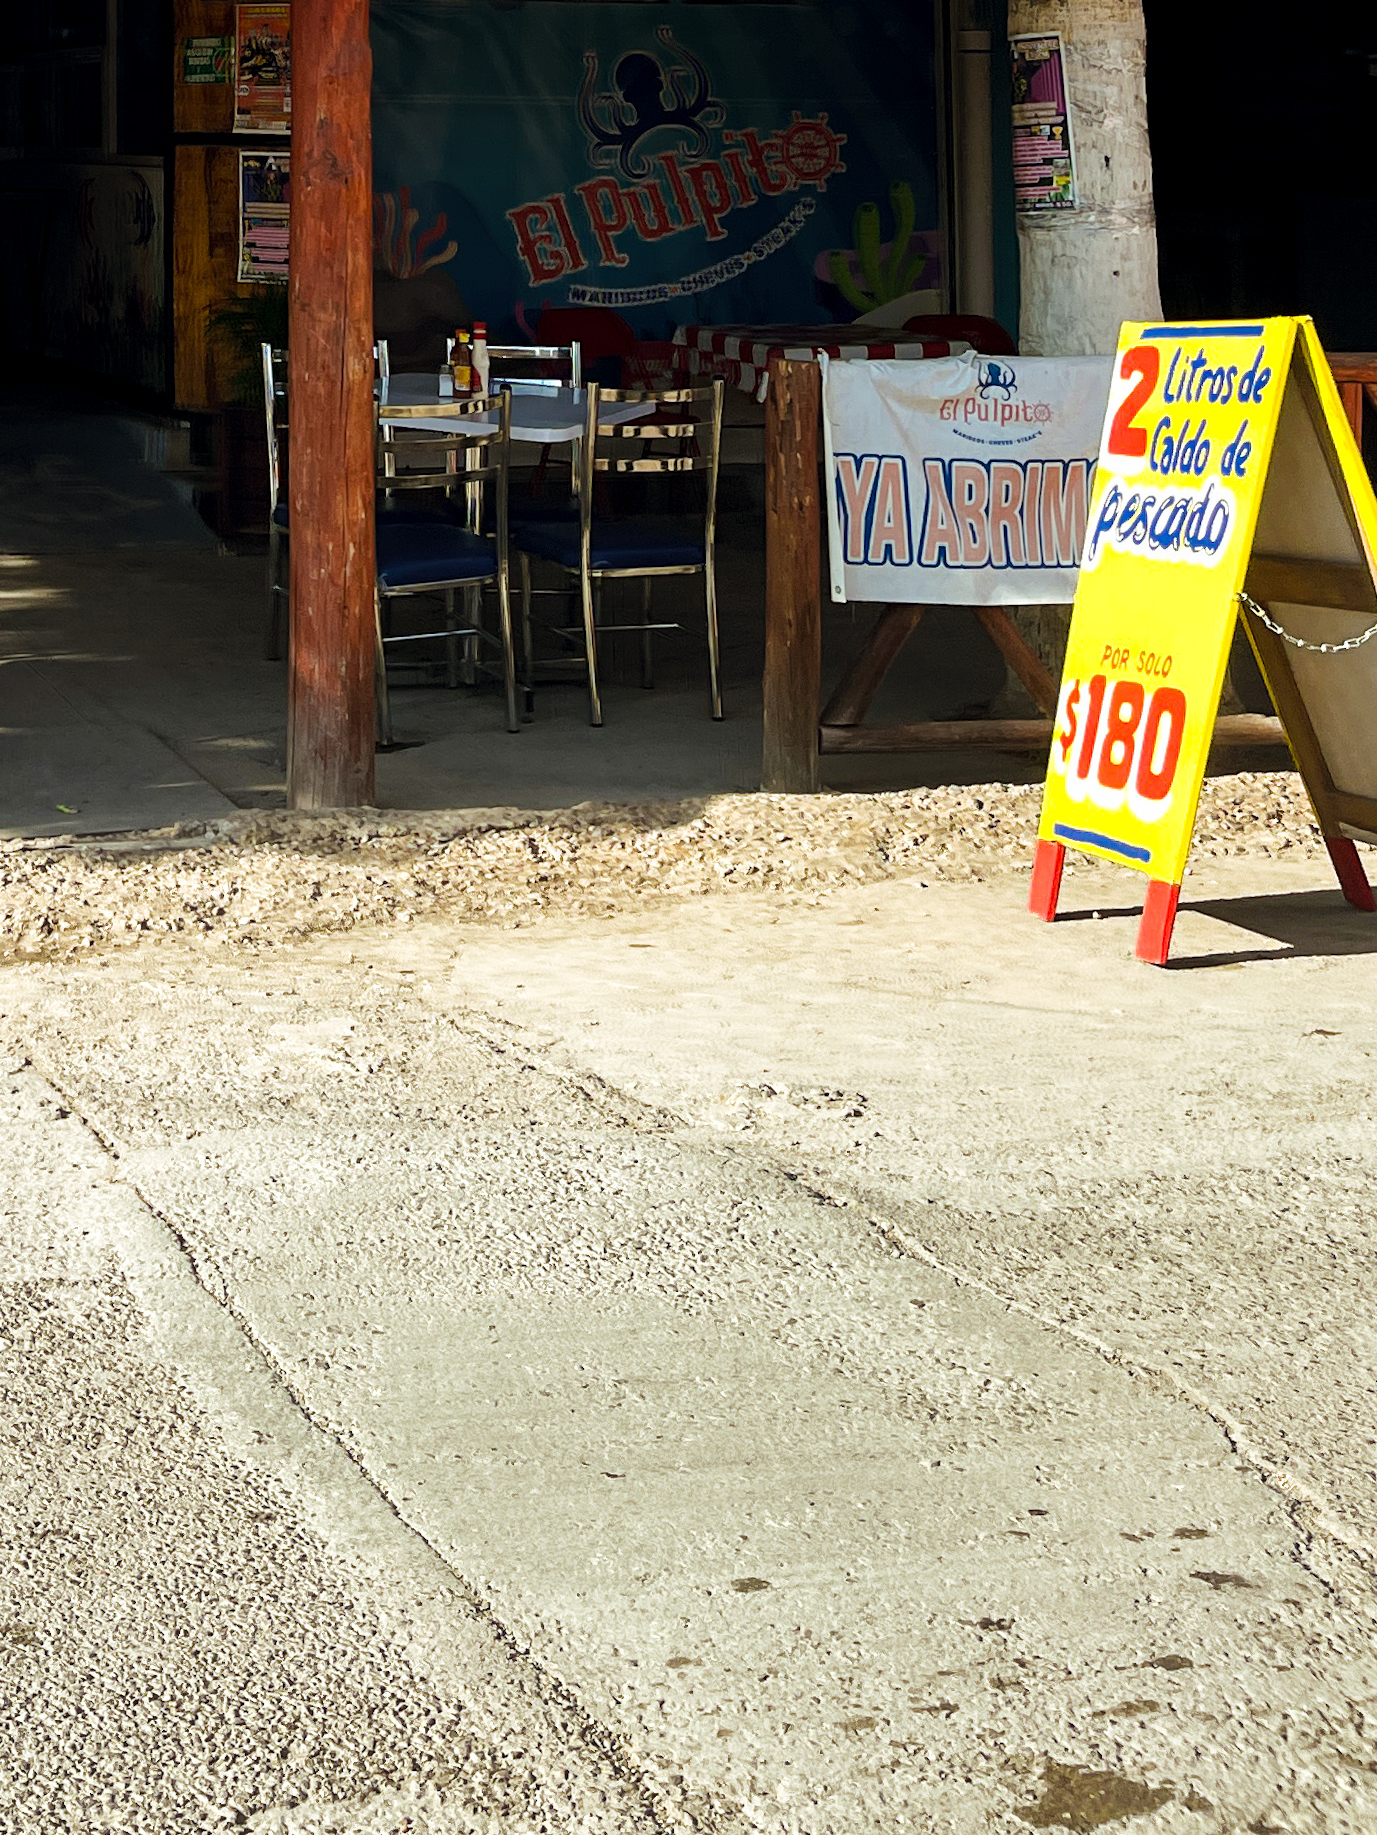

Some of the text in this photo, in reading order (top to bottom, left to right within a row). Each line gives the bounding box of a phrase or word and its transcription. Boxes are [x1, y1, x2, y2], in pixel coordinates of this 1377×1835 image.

[505, 111, 848, 287] El Pulpito
[568, 285, 674, 307] MARISCOS
[677, 254, 747, 294] CHEVES
[939, 398, 959, 420] El
[1108, 345, 1272, 457] 2 Litros de
[1150, 416, 1251, 477] Caldo de
[833, 453, 1098, 569] YA ABRIM
[1088, 483, 1230, 561] pescado
[1100, 644, 1172, 678] POR SOLO
[1059, 674, 1187, 800] $180
